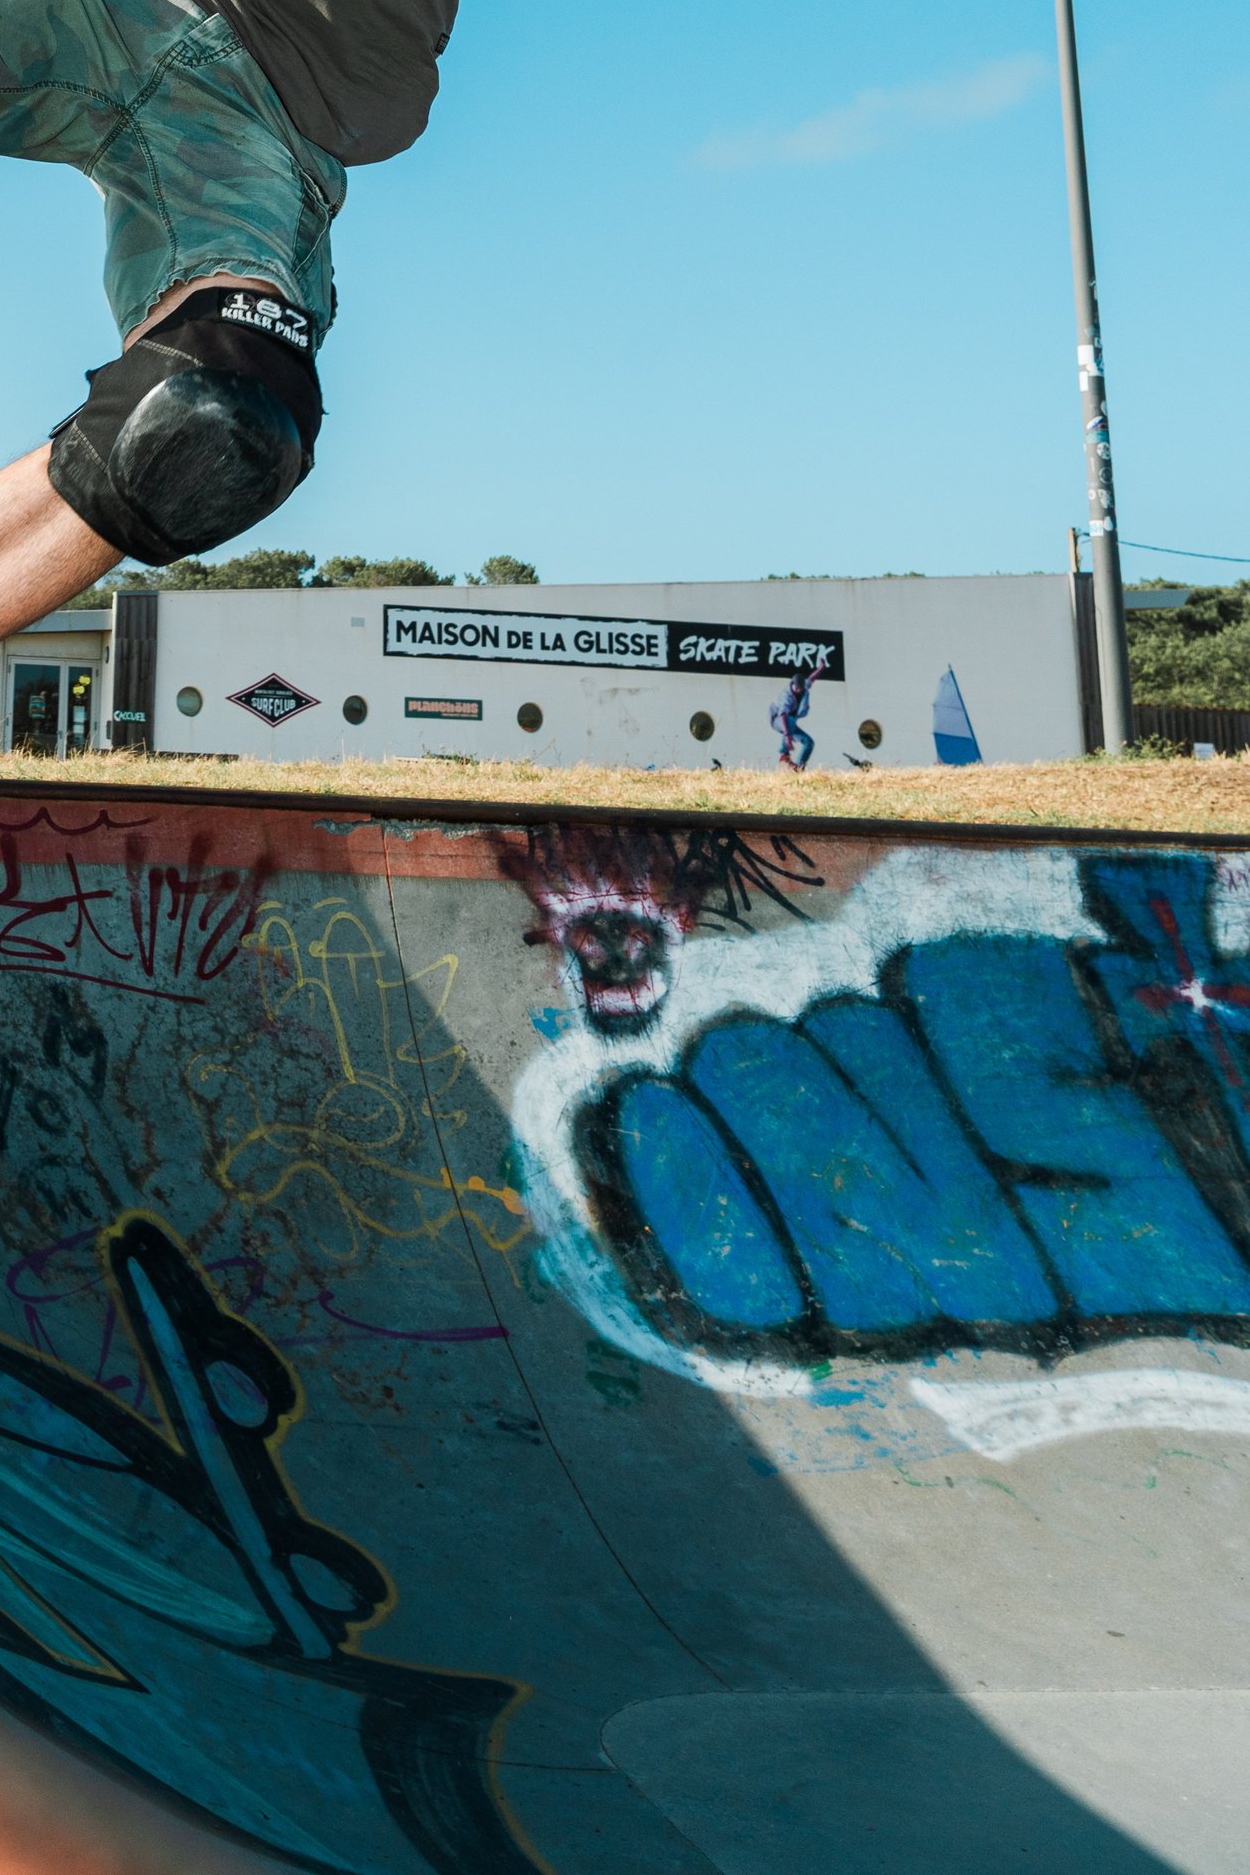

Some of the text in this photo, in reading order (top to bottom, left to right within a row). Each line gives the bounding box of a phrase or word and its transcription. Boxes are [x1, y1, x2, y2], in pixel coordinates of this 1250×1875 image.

[221, 307, 309, 348] KILLER PADS
[230, 293, 308, 330] 187
[395, 619, 659, 657] MAISON DE LA GLISSE
[678, 635, 836, 669] SKATE PARK
